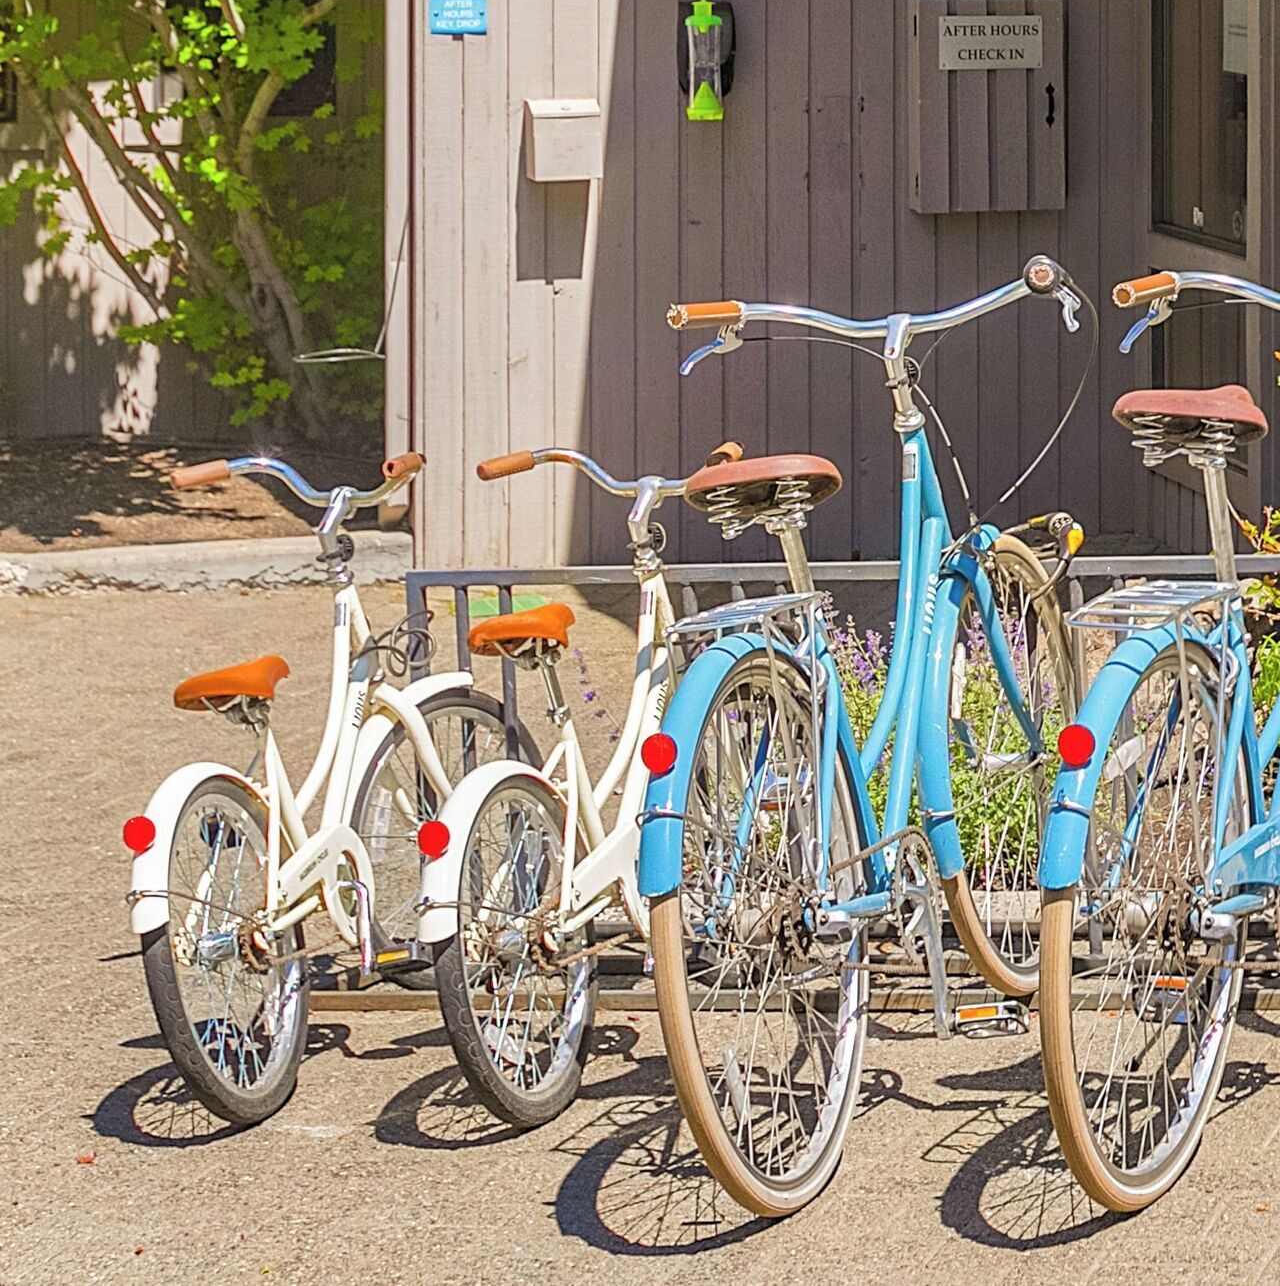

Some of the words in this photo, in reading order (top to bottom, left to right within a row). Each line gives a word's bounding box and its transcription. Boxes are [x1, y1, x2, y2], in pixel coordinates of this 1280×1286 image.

[943, 25, 987, 37] AFTER
[990, 24, 1039, 36] HOURS
[957, 48, 1006, 61] CHECK
[1009, 48, 1025, 60] IN
